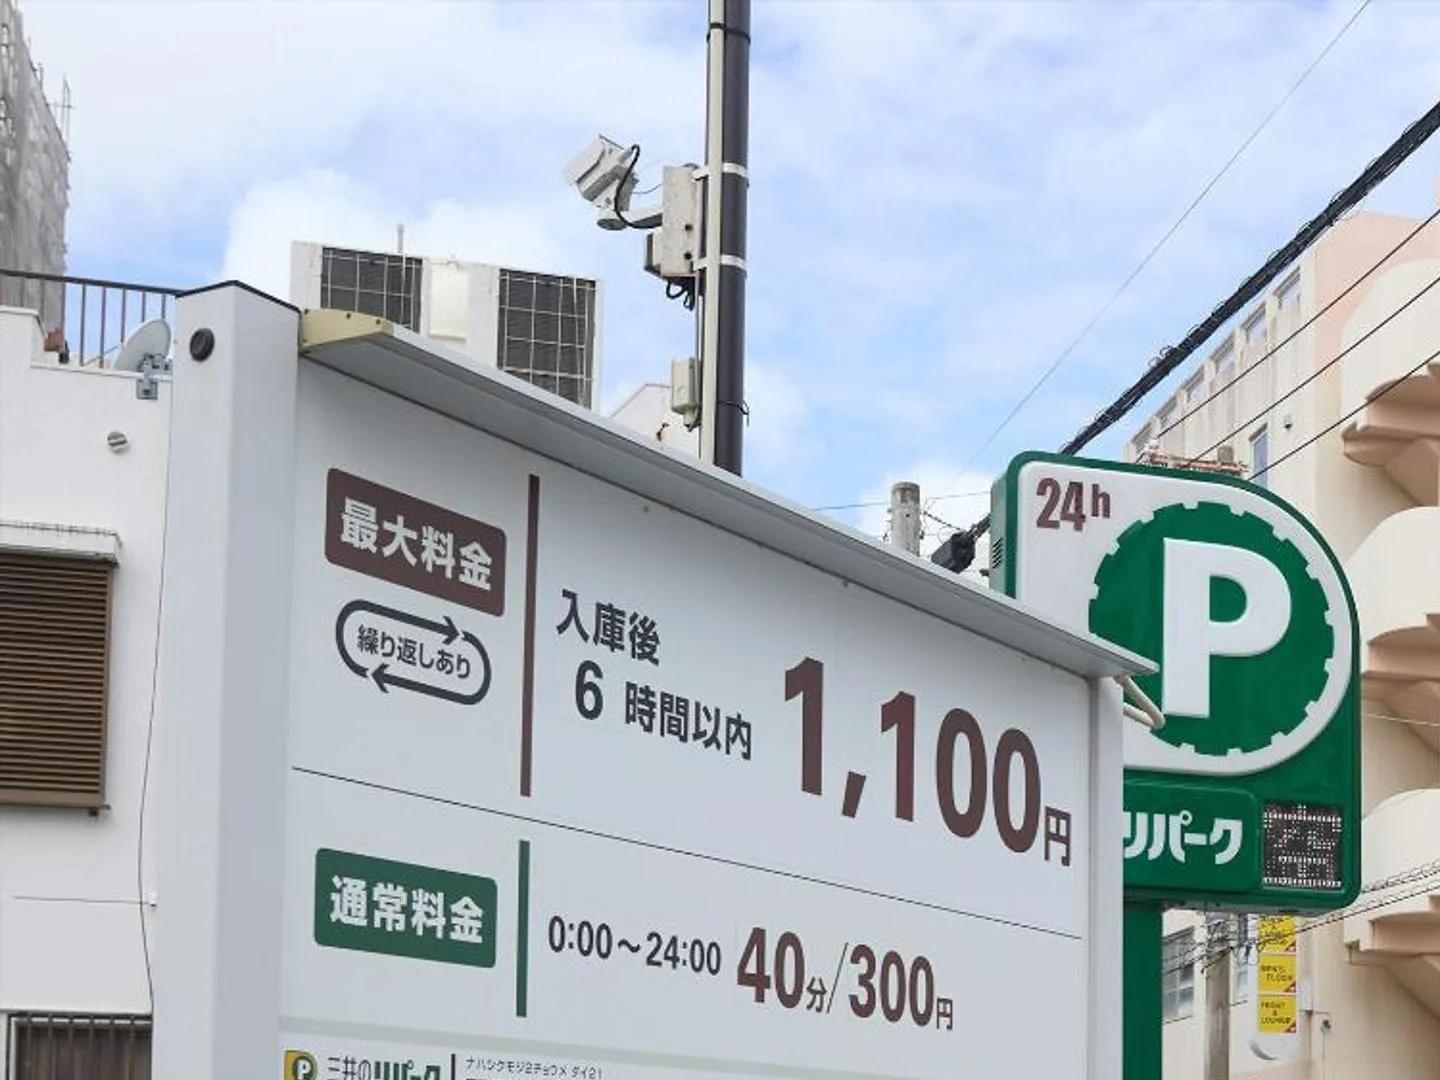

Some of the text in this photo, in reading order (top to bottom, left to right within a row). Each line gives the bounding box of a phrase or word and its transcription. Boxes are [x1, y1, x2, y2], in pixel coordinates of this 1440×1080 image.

[340, 497, 494, 591] 最大料金
[1035, 477, 1111, 532] 24h
[357, 624, 471, 681] 繰り返しあり
[556, 588, 660, 667] 入庫後
[1163, 537, 1292, 719] P
[576, 660, 753, 761] 6 時間以内
[330, 876, 484, 944] 通常料金
